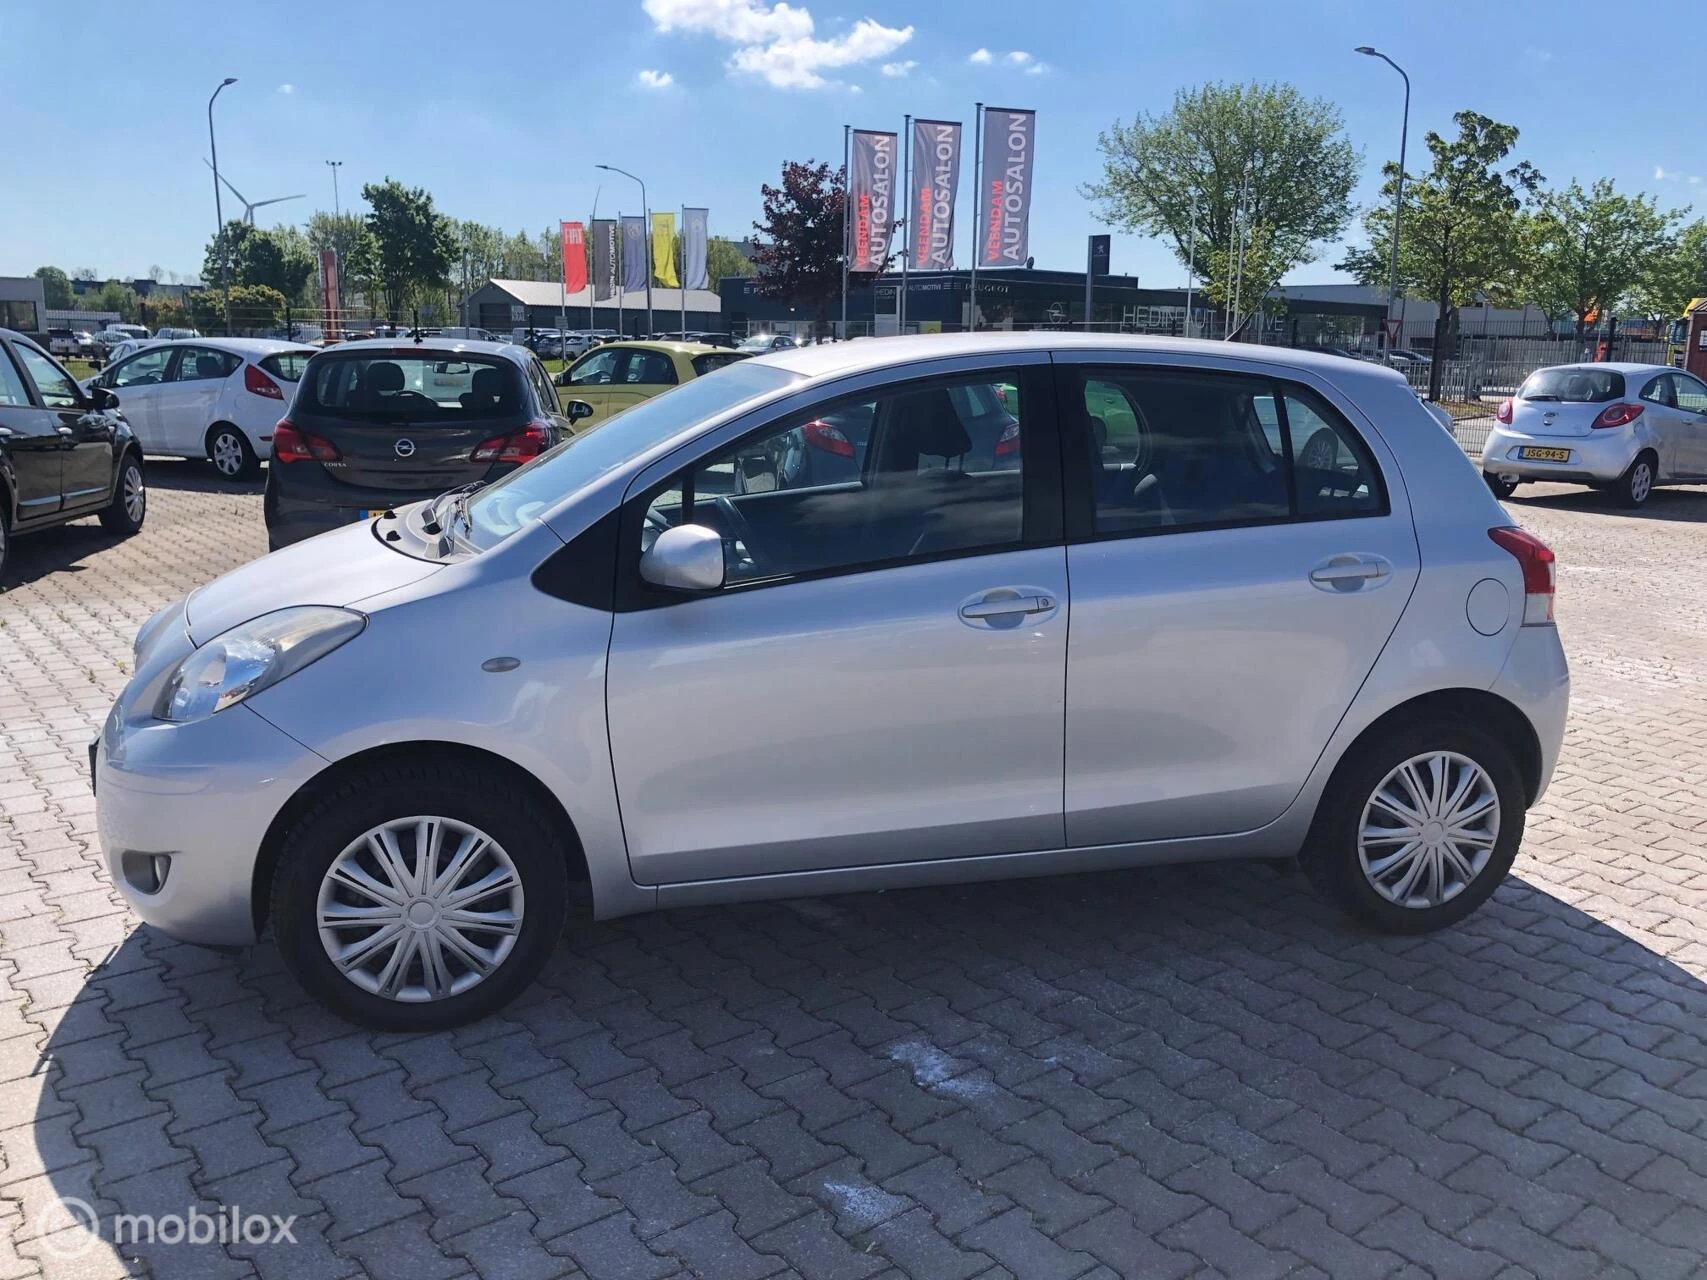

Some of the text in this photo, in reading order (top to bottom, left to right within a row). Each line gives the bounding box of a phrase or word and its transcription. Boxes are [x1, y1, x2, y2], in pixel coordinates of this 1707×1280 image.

[564, 228, 583, 245] FIAT
[870, 135, 890, 267] AUTOSALON
[931, 126, 954, 264] AUTOSALON
[1003, 114, 1027, 261] AUTOSALON
[1525, 449, 1565, 459] JSG-94-S
